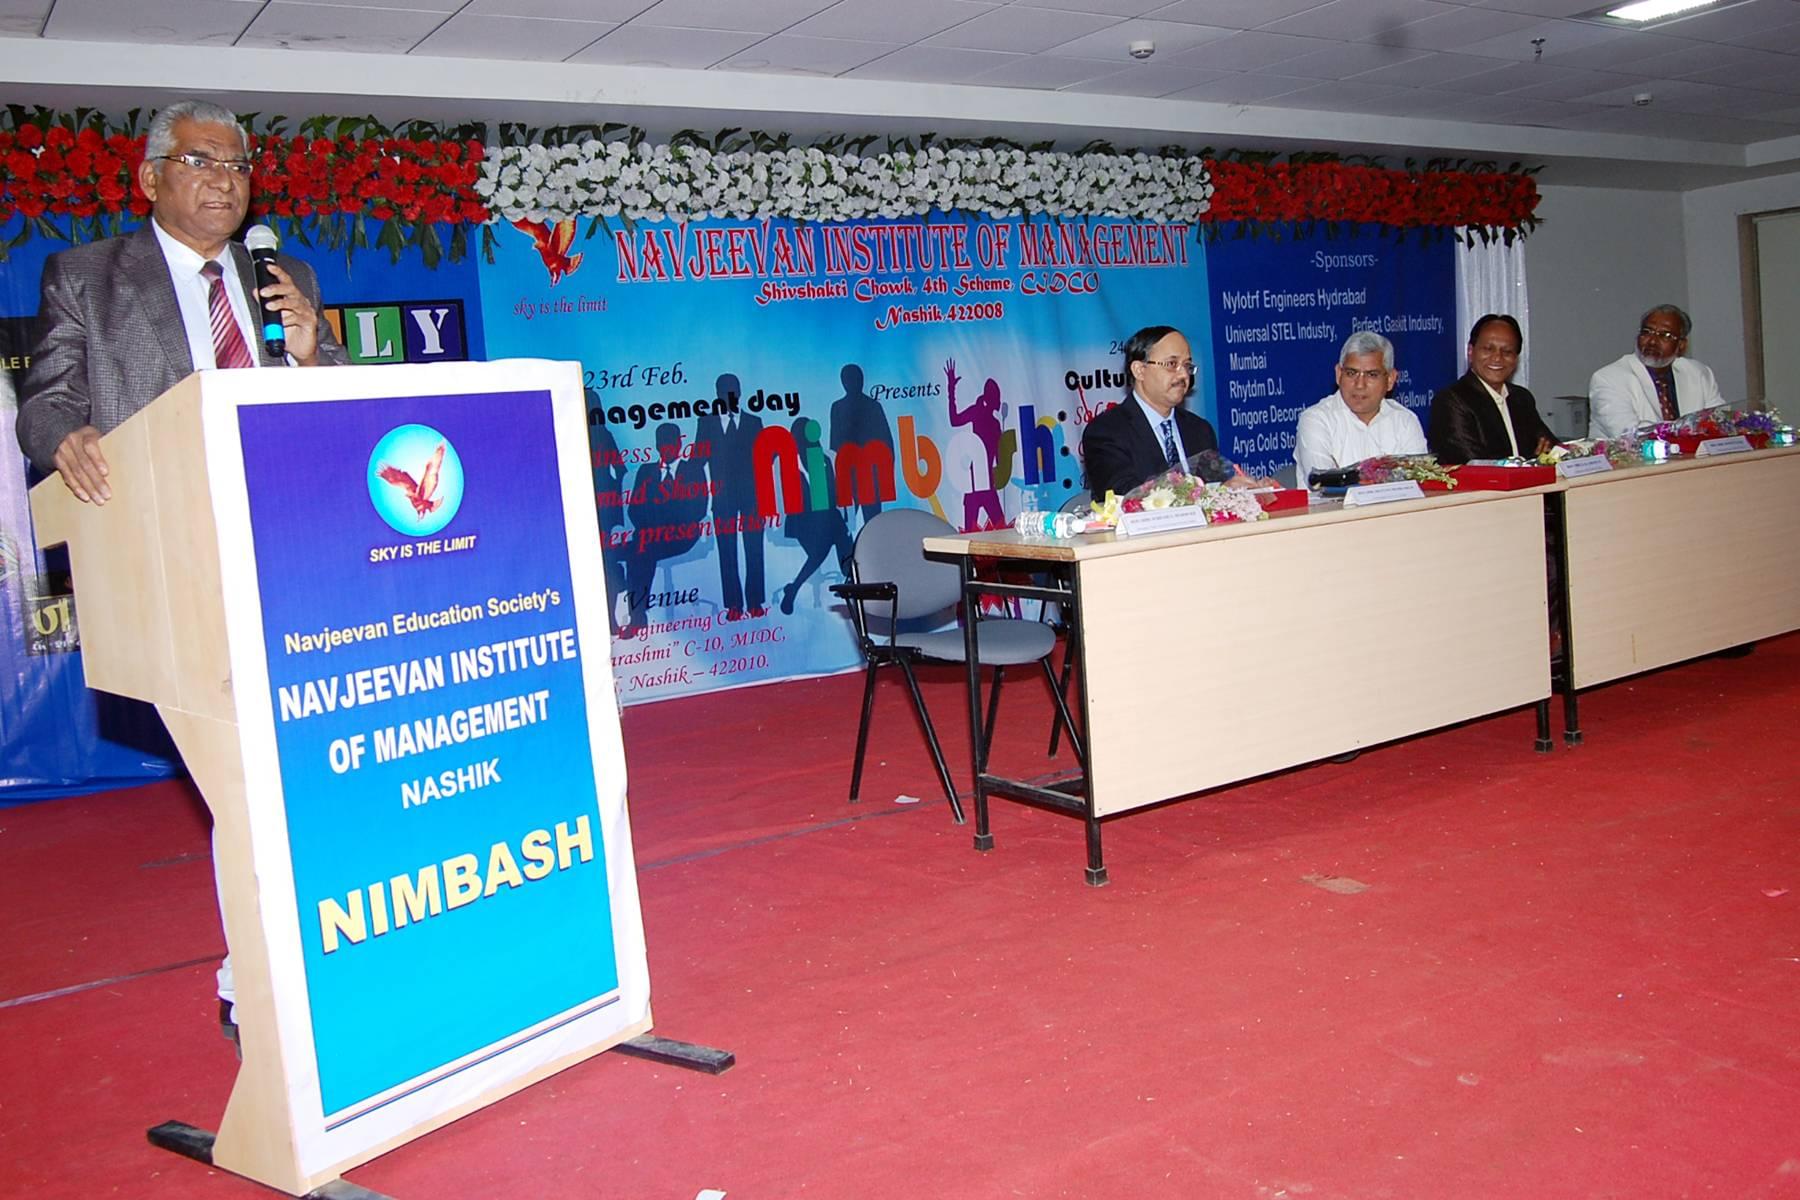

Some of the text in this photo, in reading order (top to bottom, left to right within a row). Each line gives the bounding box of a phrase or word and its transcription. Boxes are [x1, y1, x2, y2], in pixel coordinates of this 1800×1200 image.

[615, 221, 1188, 283] NAVJEEVAN INSTITUTE OF MANAGEMENT
[754, 278, 848, 306] Shivshakti
[923, 275, 948, 296] 4th
[1263, 288, 1316, 313] Engineers
[1317, 287, 1367, 311] Hydrabad
[513, 294, 608, 320] sky is the limit
[1225, 321, 1337, 343] Universal STEL Industry,
[1352, 316, 1382, 333] Perfect
[1229, 351, 1267, 371] Mumbai
[584, 361, 687, 390] 23rd Feb.
[869, 382, 941, 402] Presents
[1229, 377, 1285, 403] Rhytdm D.J.
[588, 389, 801, 430] nagement day
[1231, 407, 1268, 430] Dingore
[659, 434, 712, 468] plan
[1232, 435, 1256, 458] Arya
[1256, 432, 1279, 452] Cold
[656, 474, 724, 504] Show
[638, 512, 782, 553] presentation
[369, 535, 477, 563] SKY IS THE LIMIT
[623, 586, 699, 610] Venue
[284, 588, 561, 654] Navjeevan Education Society's
[616, 614, 711, 642] Engineering
[730, 626, 786, 648] MIDC,
[278, 628, 577, 721] NAVJEEVAN INSTITUTE
[629, 665, 693, 692] Nashik
[708, 654, 769, 677] 422010.
[329, 690, 549, 774] OF MANAGEMENT
[400, 758, 502, 809] NASHIK
[317, 815, 594, 954] NIMBASH
